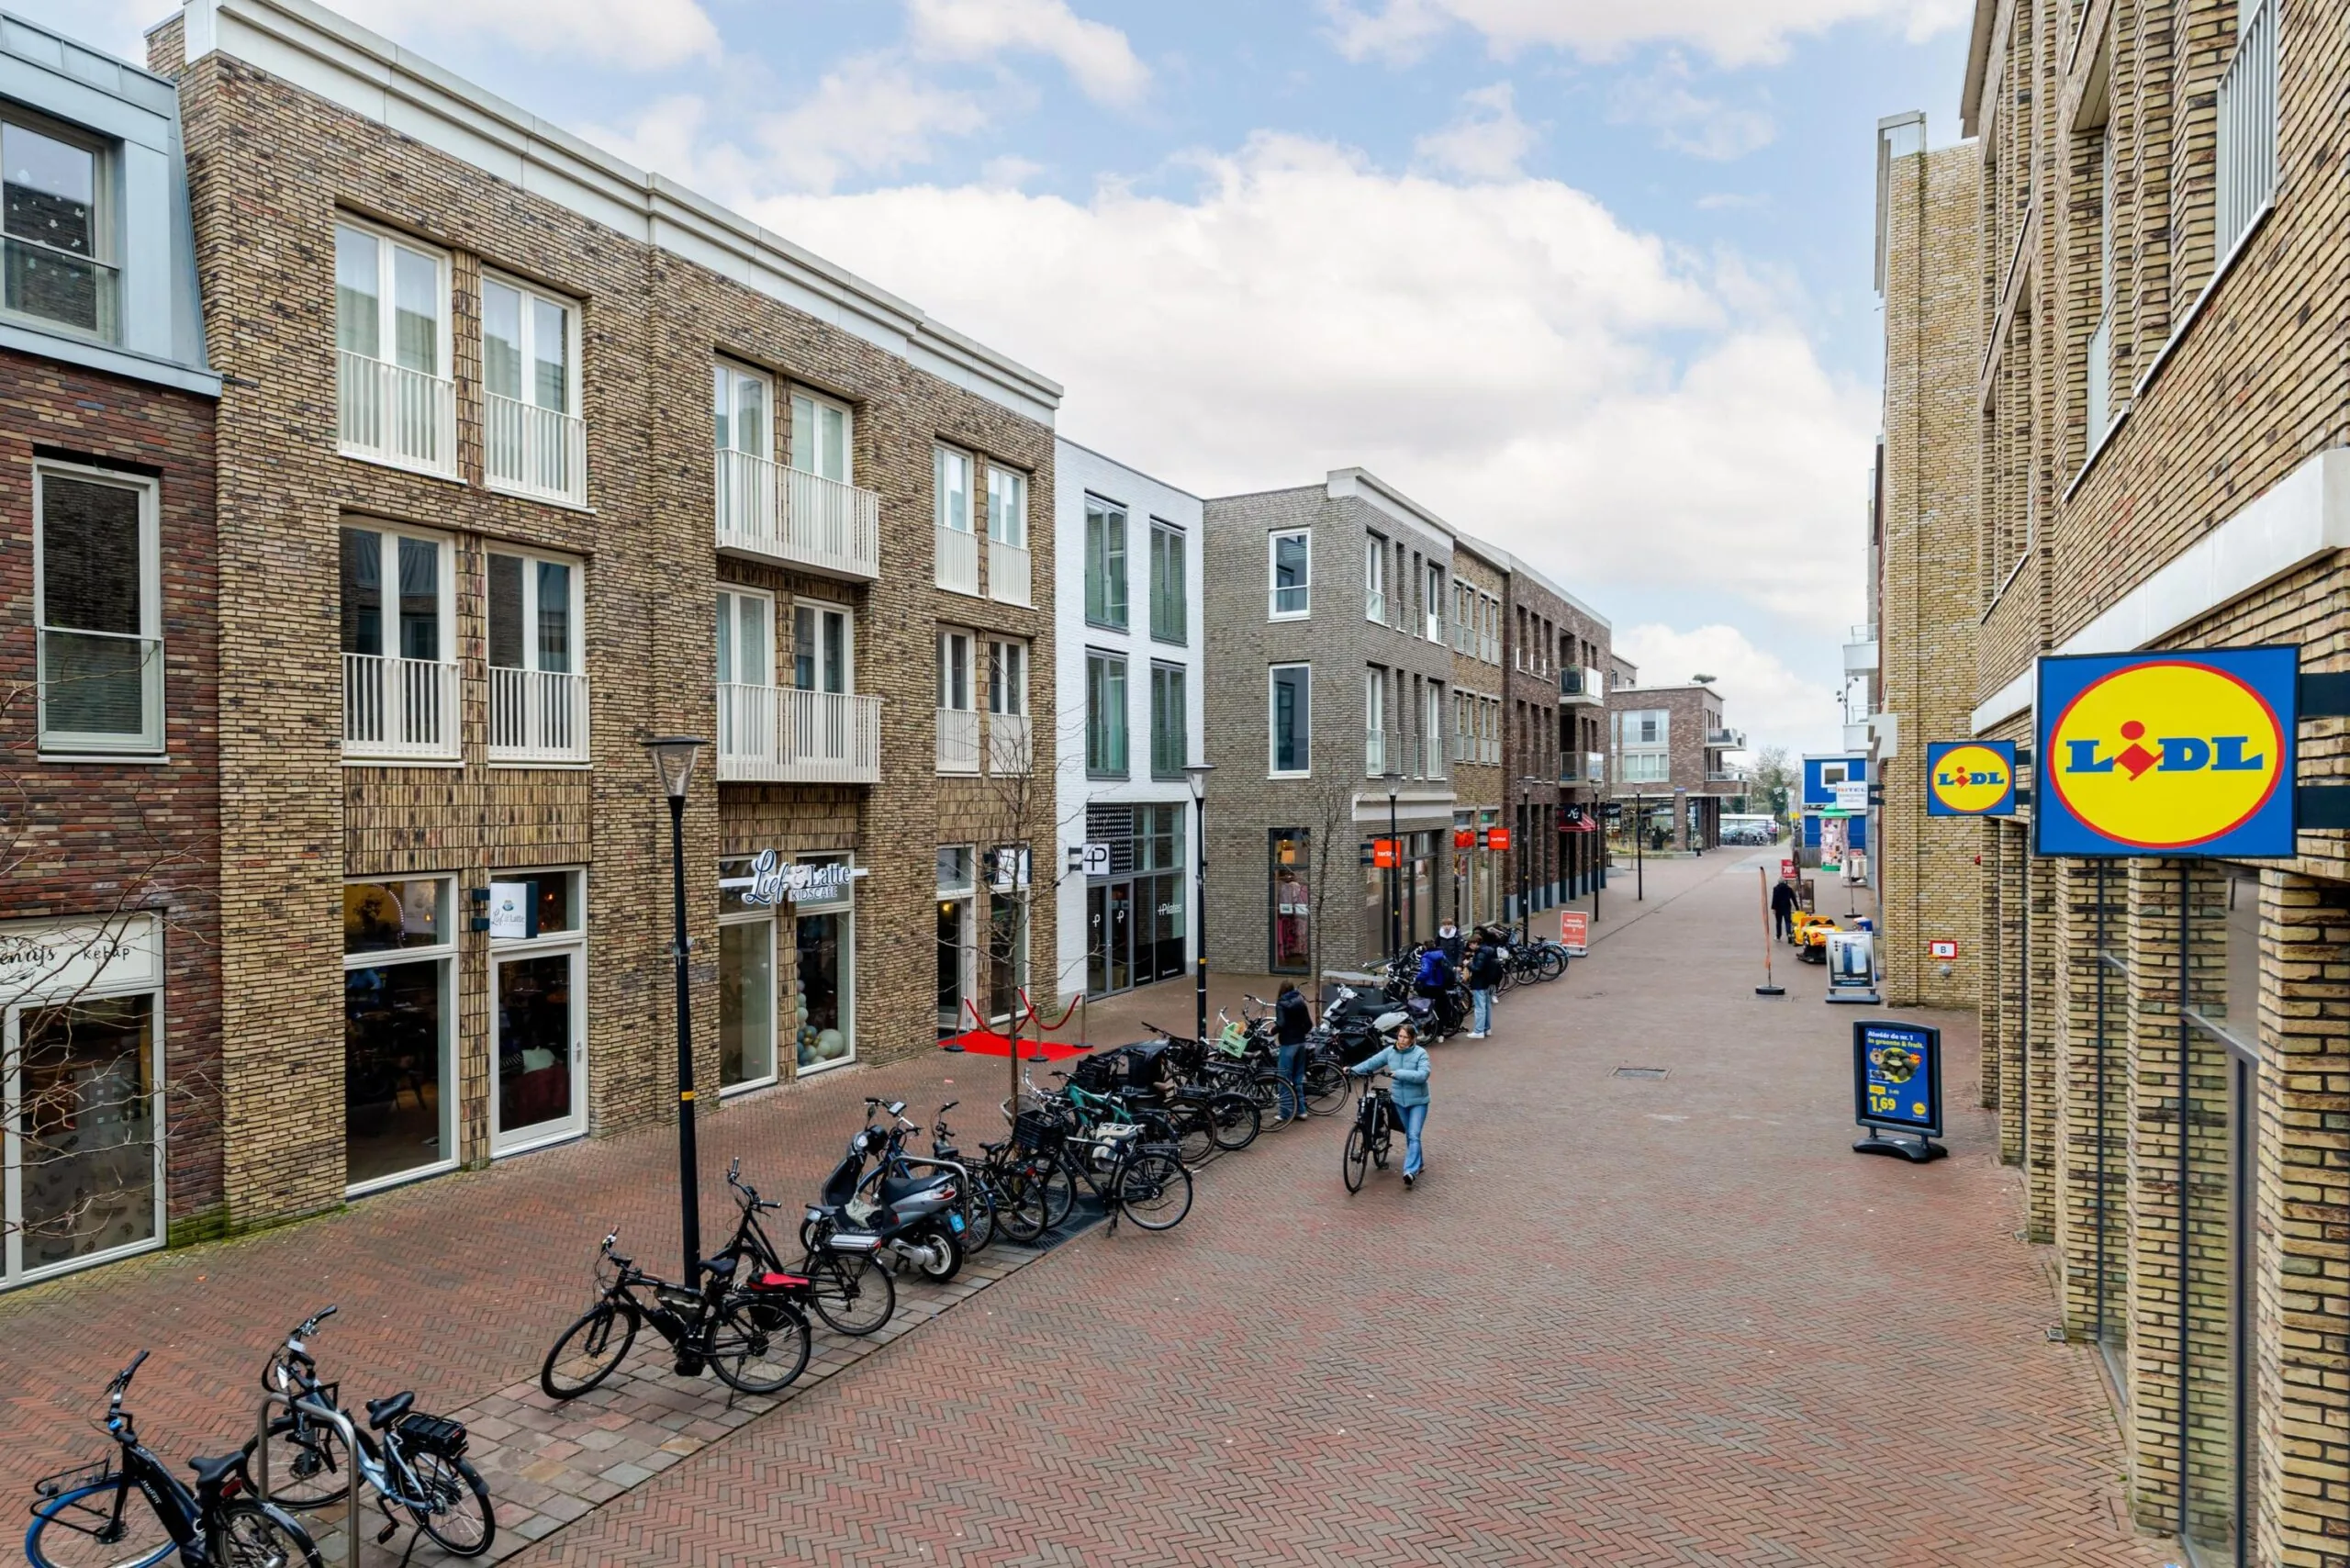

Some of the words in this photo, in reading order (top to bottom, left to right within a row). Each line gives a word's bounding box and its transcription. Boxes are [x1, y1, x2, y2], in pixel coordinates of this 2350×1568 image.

[744, 849, 789, 903] Lief
[810, 865, 851, 887] Latte
[1870, 1096, 1897, 1113] 1.69
